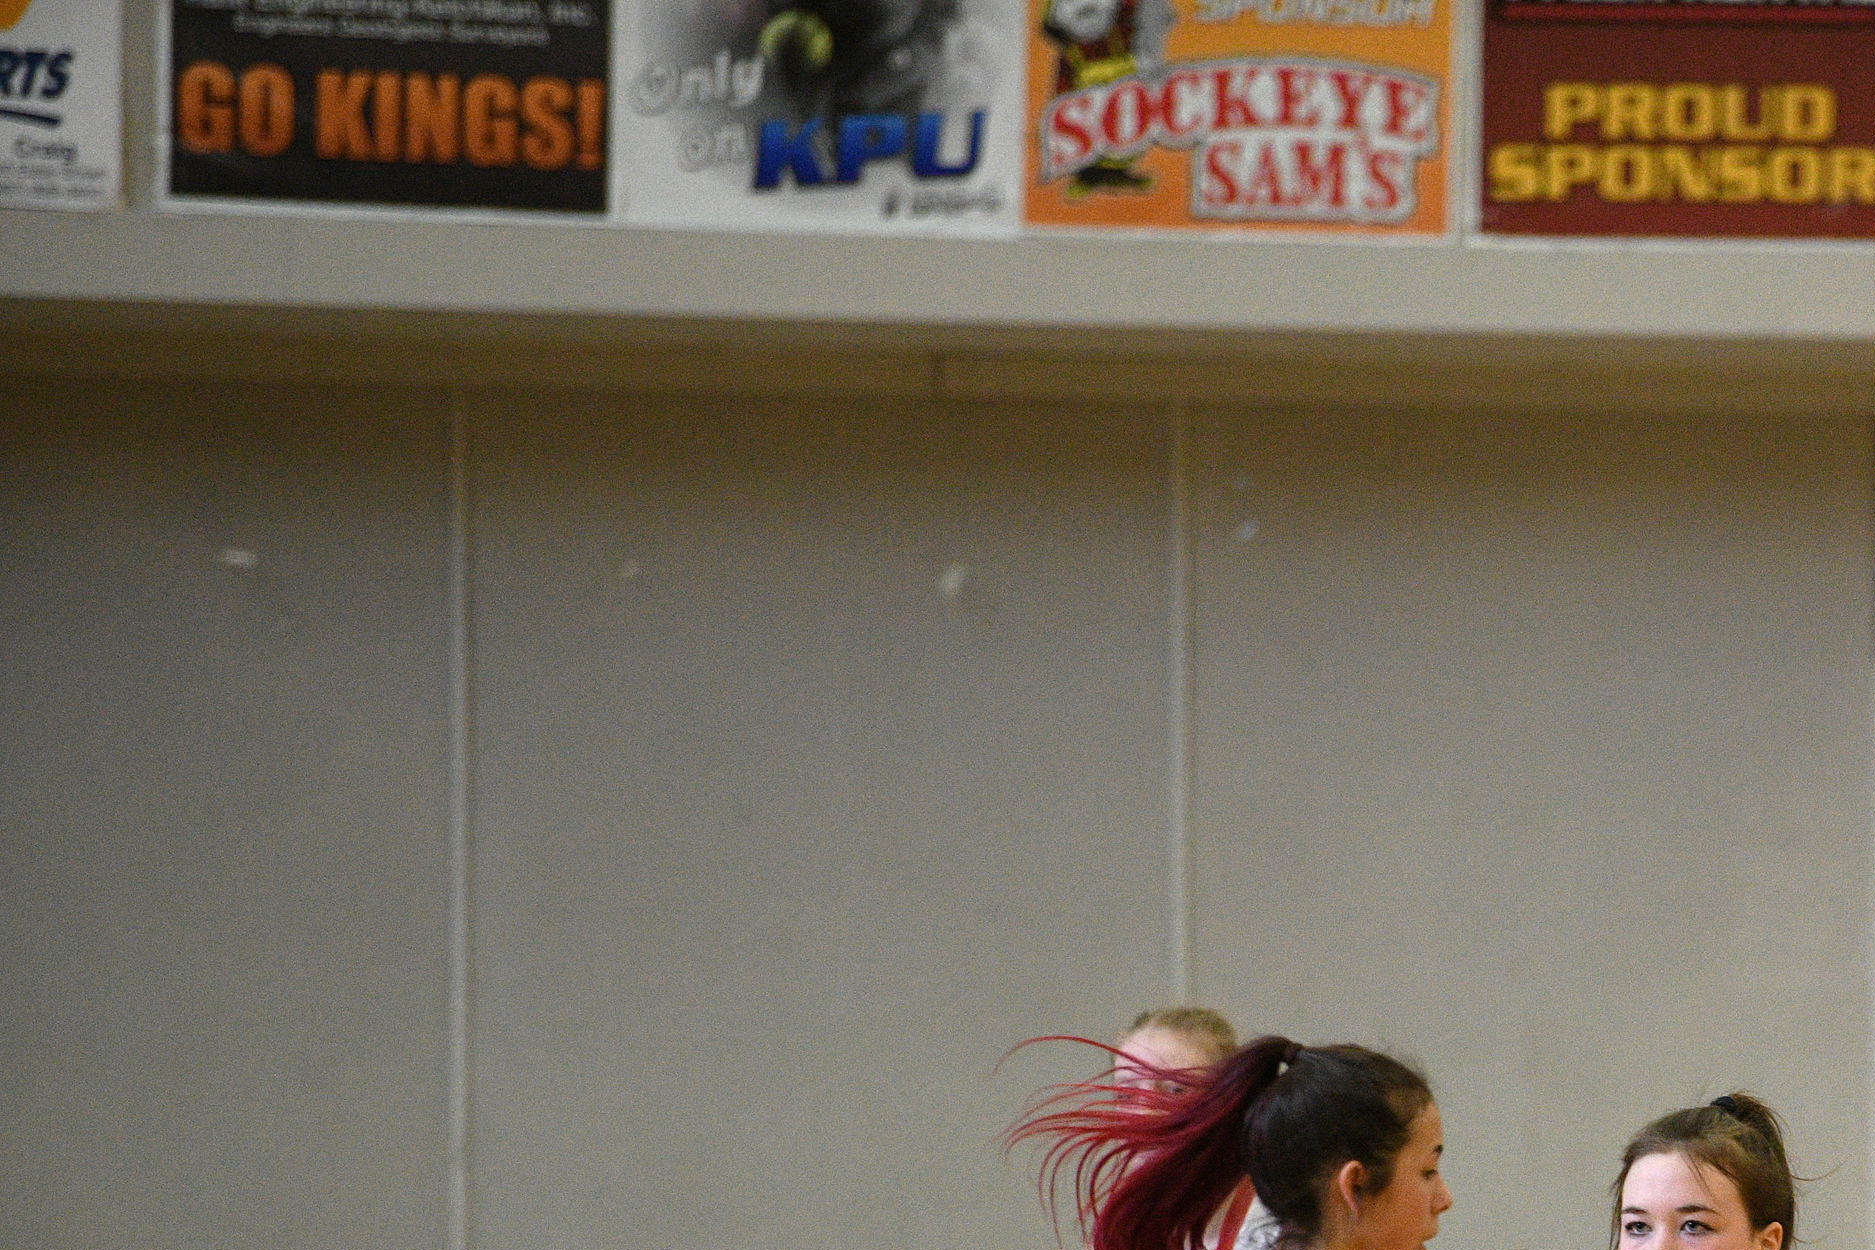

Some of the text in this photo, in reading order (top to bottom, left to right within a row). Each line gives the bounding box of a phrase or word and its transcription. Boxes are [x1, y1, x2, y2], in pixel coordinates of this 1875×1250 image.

[178, 60, 603, 170] GO KINGS!
[753, 110, 986, 190] KPU
[1050, 66, 1430, 166] SOCKEYE
[1542, 82, 1837, 141] PROUD
